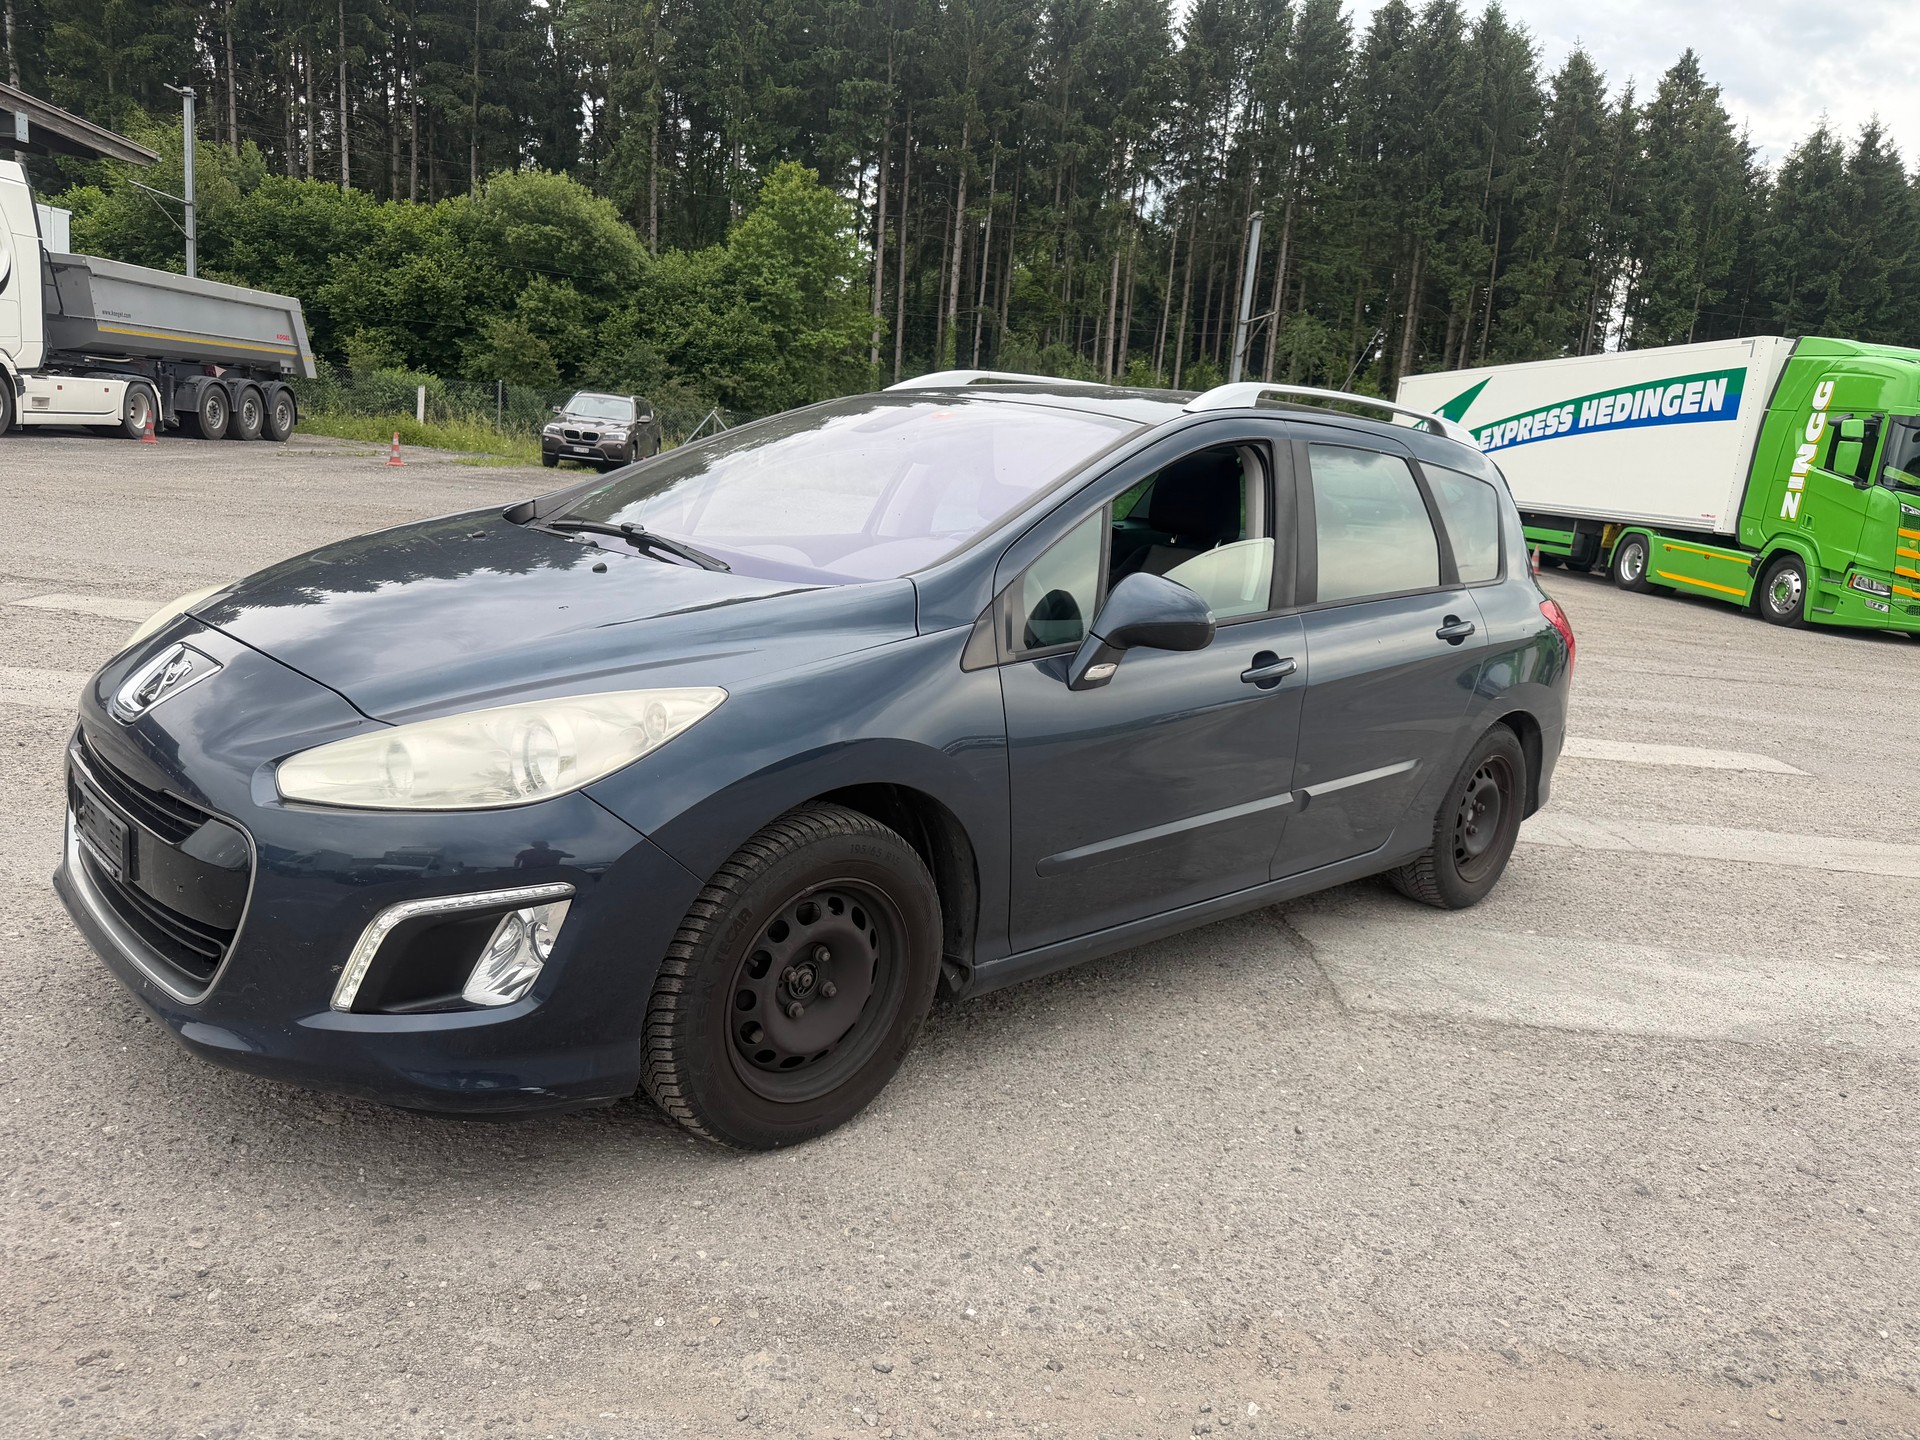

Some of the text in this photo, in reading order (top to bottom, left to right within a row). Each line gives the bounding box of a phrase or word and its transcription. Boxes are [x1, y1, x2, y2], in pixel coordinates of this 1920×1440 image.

[1479, 404, 1574, 450] EXPRESS
[1578, 378, 1729, 428] HEDINGEN
[1780, 381, 1835, 521] ZINGG
